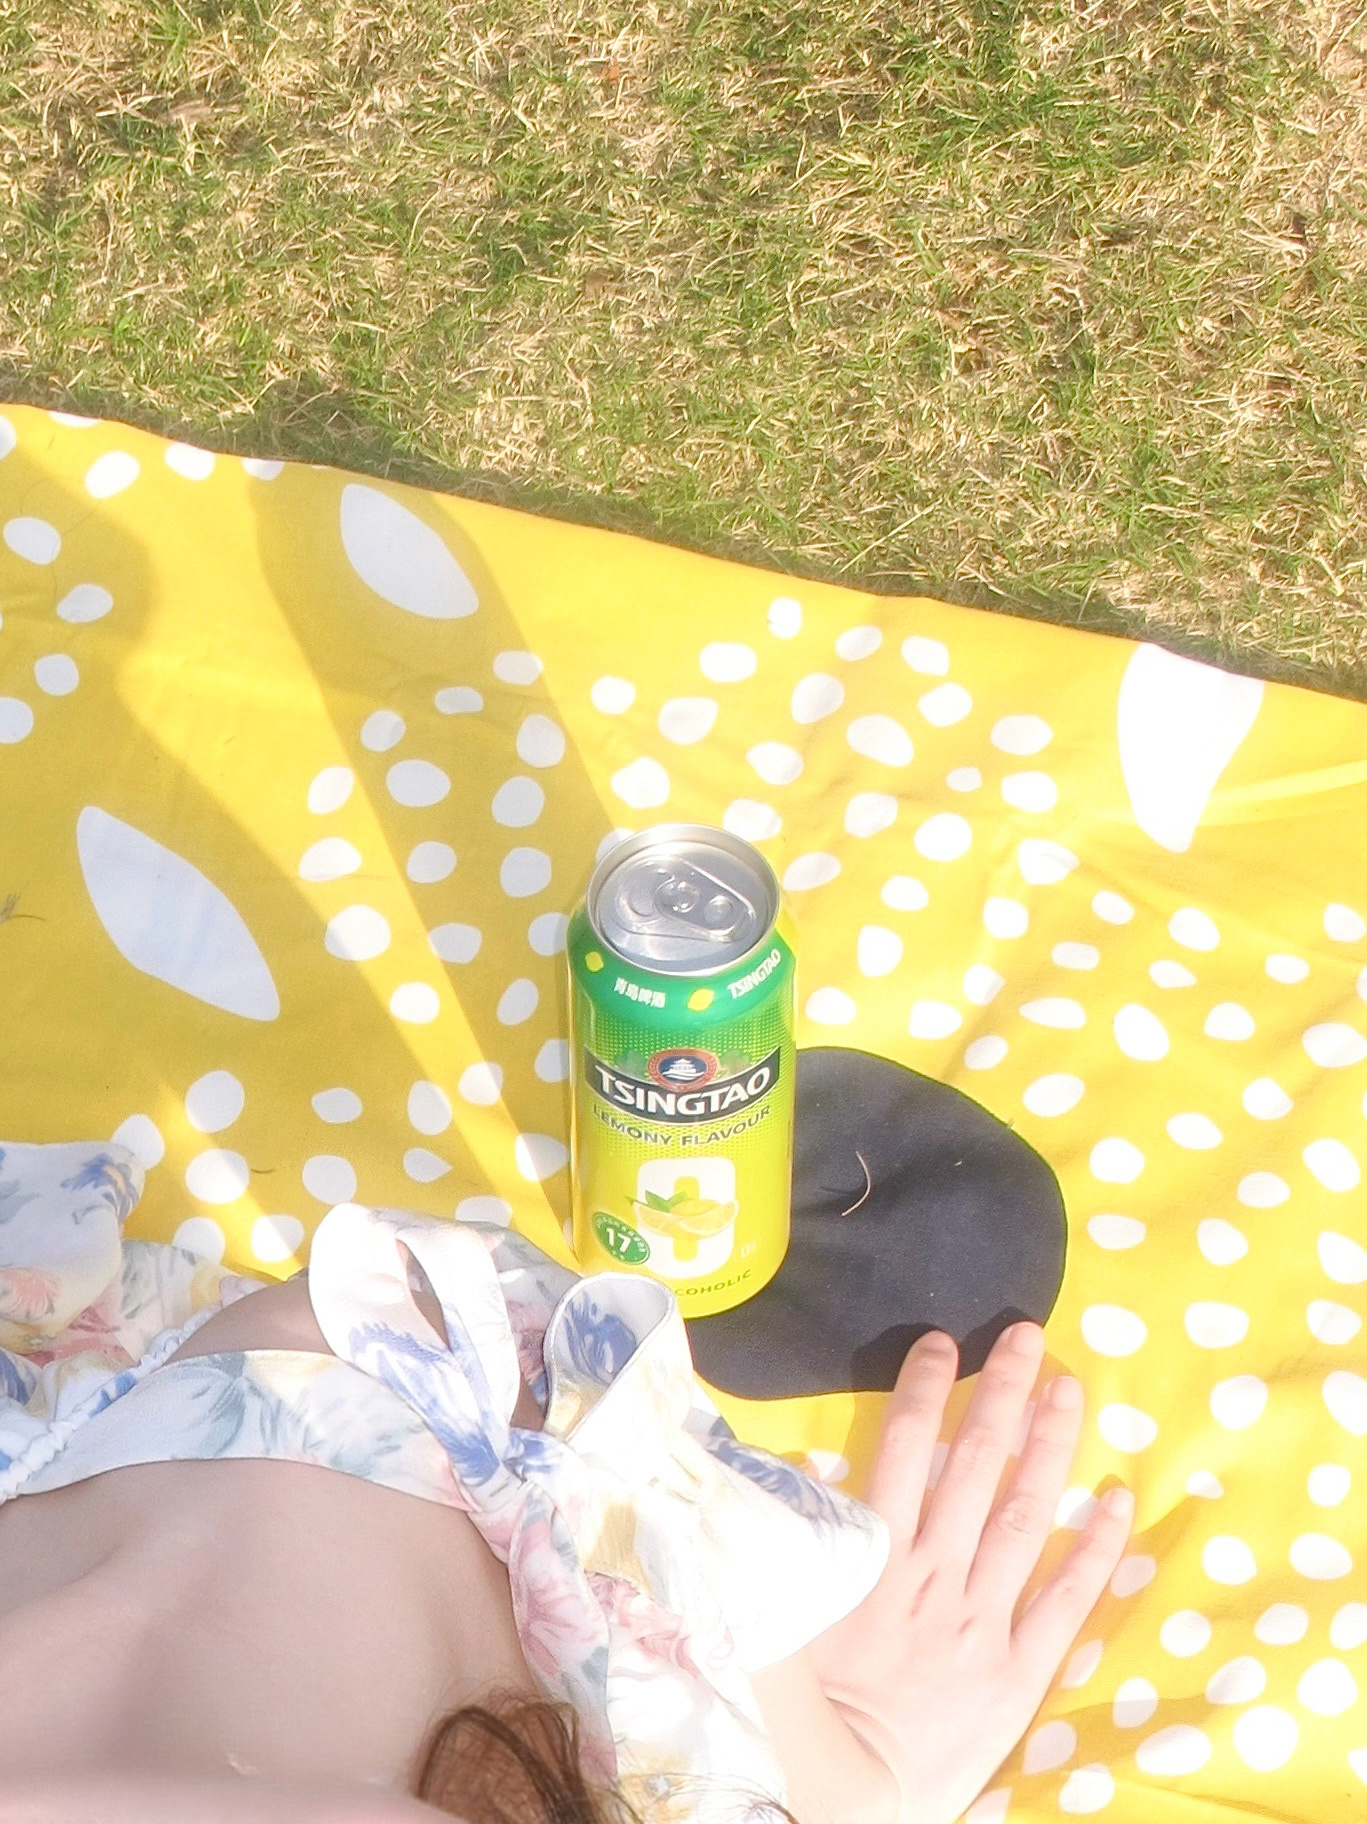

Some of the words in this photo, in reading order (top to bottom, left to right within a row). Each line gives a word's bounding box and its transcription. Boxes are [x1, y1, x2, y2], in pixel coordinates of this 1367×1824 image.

[726, 949, 782, 1000] TSINGTAO
[595, 1066, 771, 1116] TSINGTAO
[593, 1104, 673, 1146] LEMONY
[682, 1105, 771, 1146] FLAVOUR
[606, 1227, 631, 1254] 17
[675, 1268, 752, 1297] COHOLIC
